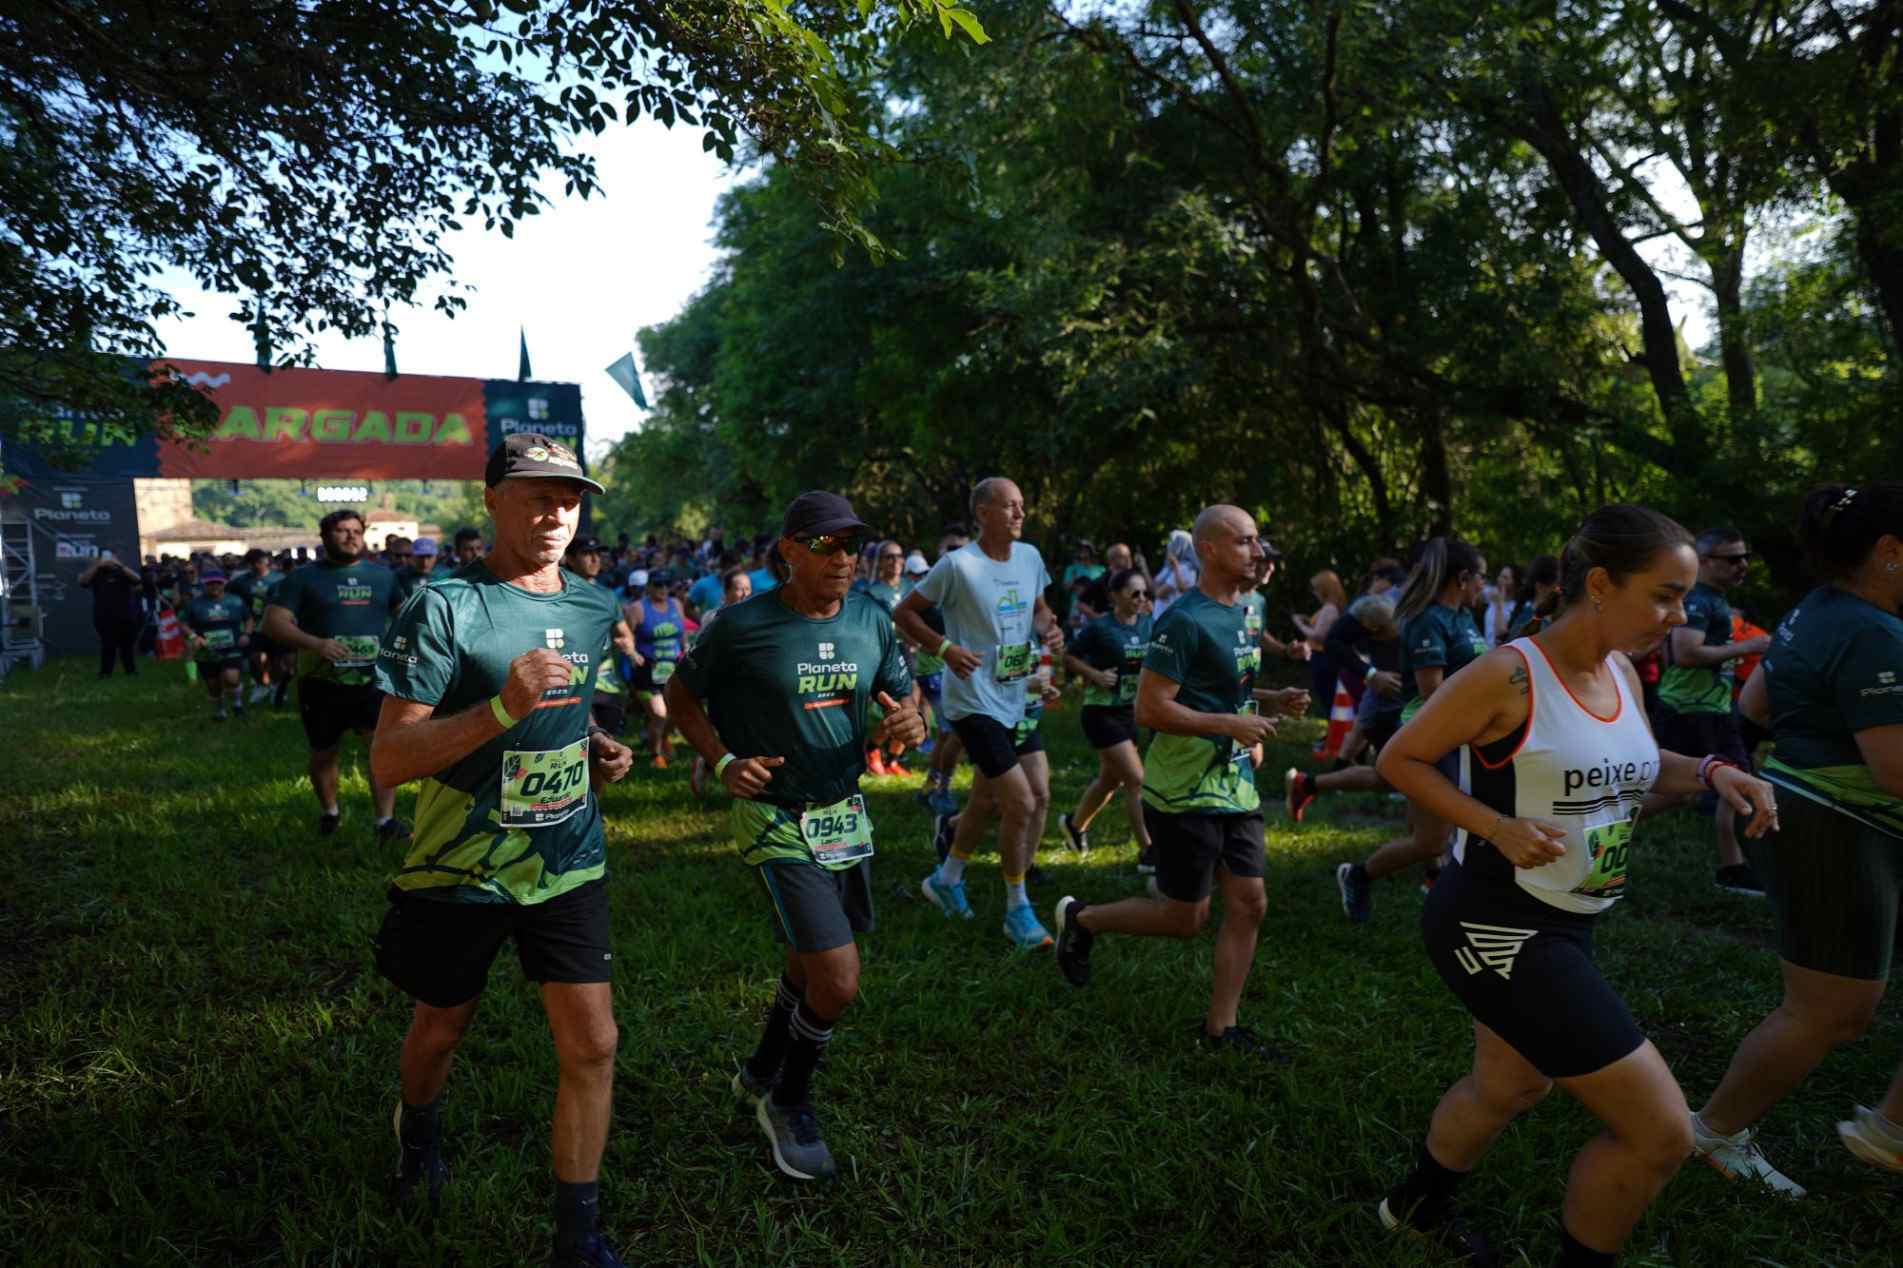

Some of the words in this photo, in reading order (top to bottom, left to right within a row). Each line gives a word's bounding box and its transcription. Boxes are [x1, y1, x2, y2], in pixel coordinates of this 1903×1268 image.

[500, 417, 578, 436] Planeta
[34, 507, 112, 521] Planeta
[797, 661, 858, 675] Planeta
[798, 673, 858, 694] RUN
[520, 760, 584, 796] 0470
[807, 813, 857, 838] 0943
[1602, 842, 1630, 873] 00
